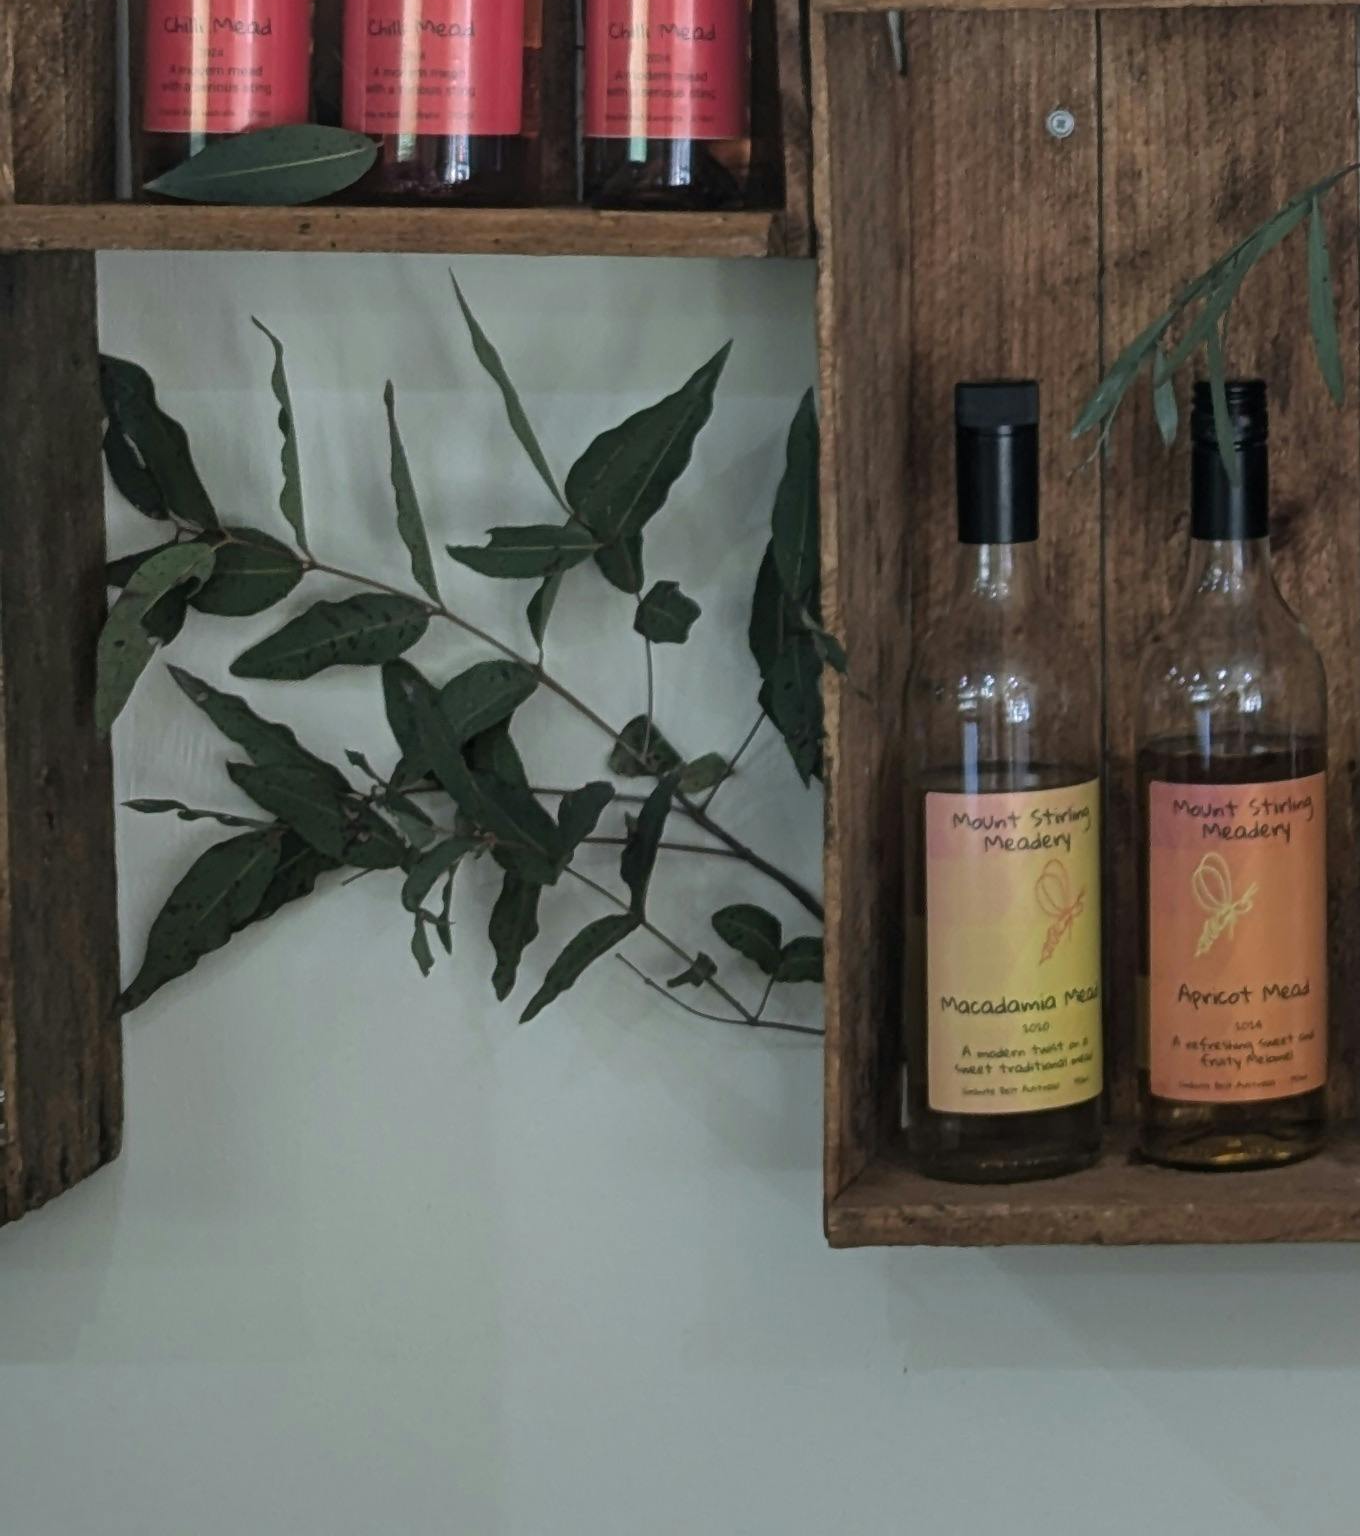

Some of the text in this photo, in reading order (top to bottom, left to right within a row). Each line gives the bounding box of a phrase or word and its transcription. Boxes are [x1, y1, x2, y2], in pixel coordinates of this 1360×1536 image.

[214, 18, 272, 36] Mead
[416, 20, 475, 38] Mead
[660, 24, 716, 42] Mead
[1173, 794, 1314, 821] Mount Stirling
[953, 806, 1091, 833] Mount Stirling
[985, 832, 1071, 852] Meadery
[1202, 822, 1291, 842] Meadery
[941, 994, 1057, 1016] Macadamia
[1178, 980, 1310, 1010] Apricot Mead
